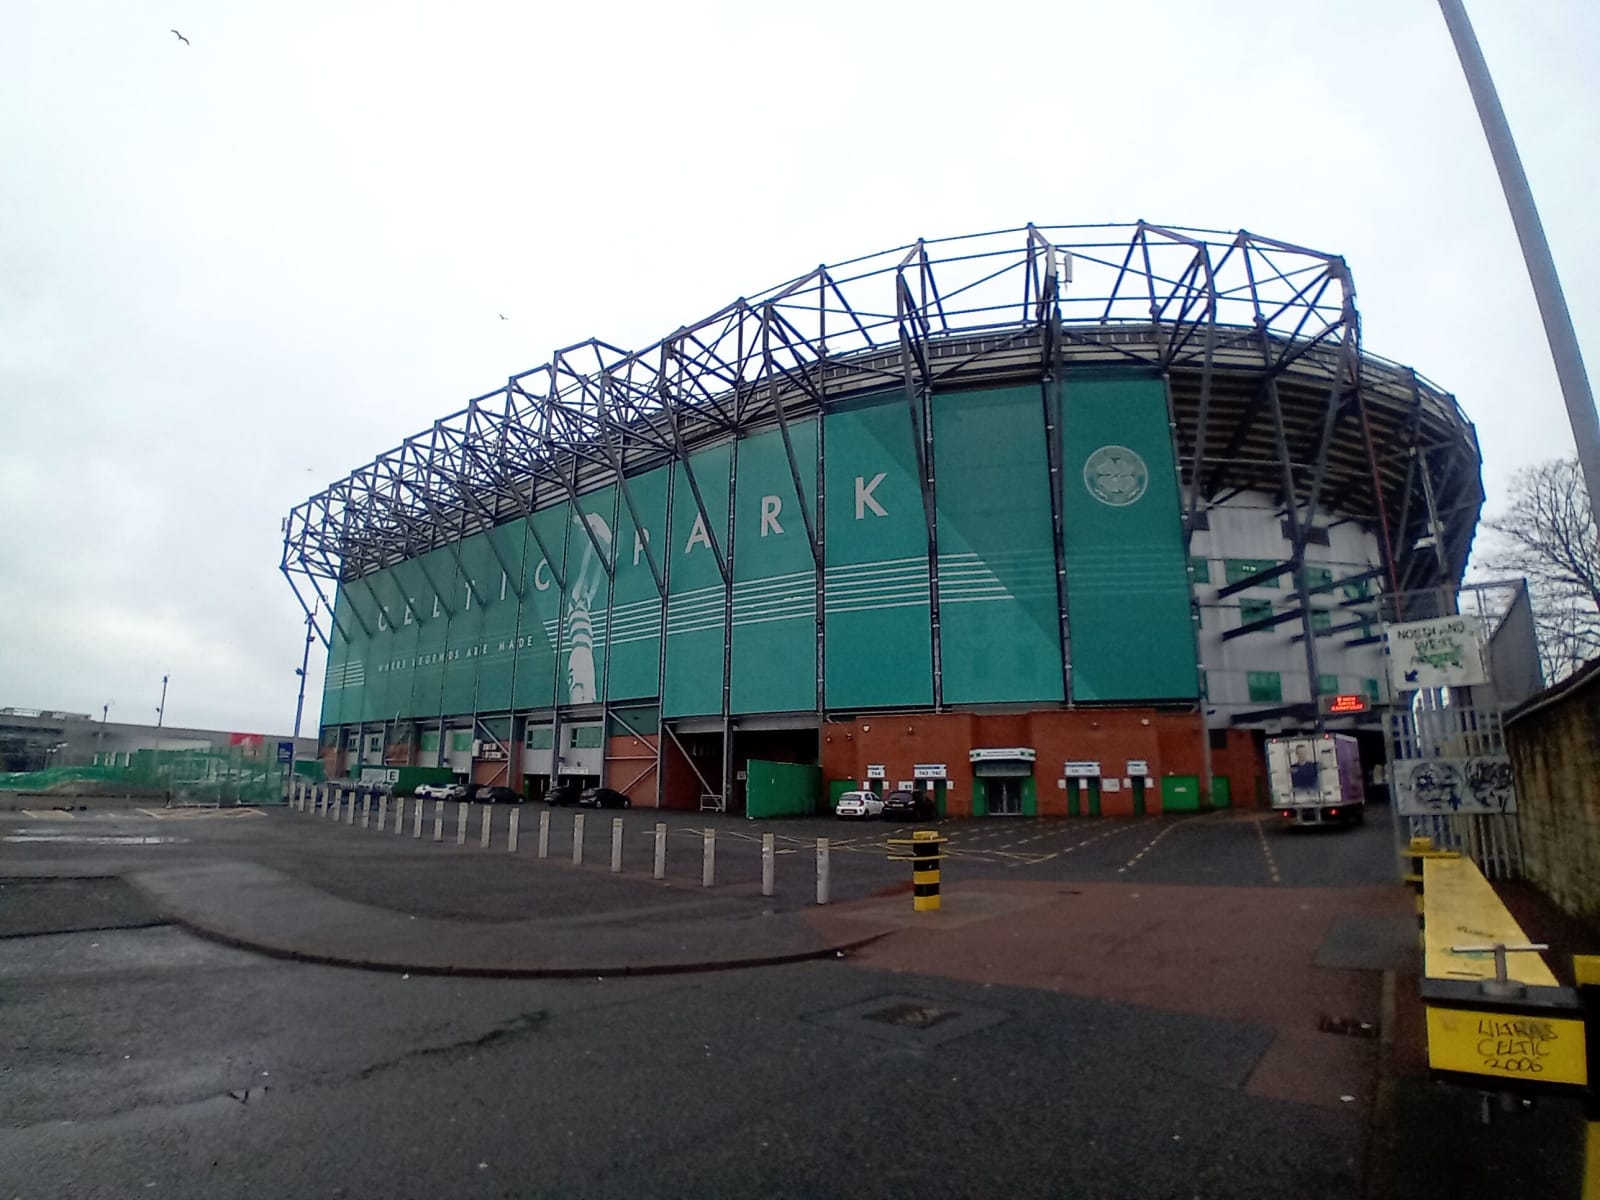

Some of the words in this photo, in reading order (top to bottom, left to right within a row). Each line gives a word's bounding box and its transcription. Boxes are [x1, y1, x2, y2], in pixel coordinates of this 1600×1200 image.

[377, 558, 550, 632] CELTIC
[633, 473, 888, 566] PARK
[466, 643, 488, 657] ARE
[498, 635, 533, 651] MADE
[389, 771, 396, 782] E
[1479, 1018, 1558, 1040] ULTRAS
[1477, 1038, 1551, 1057] CELTIC
